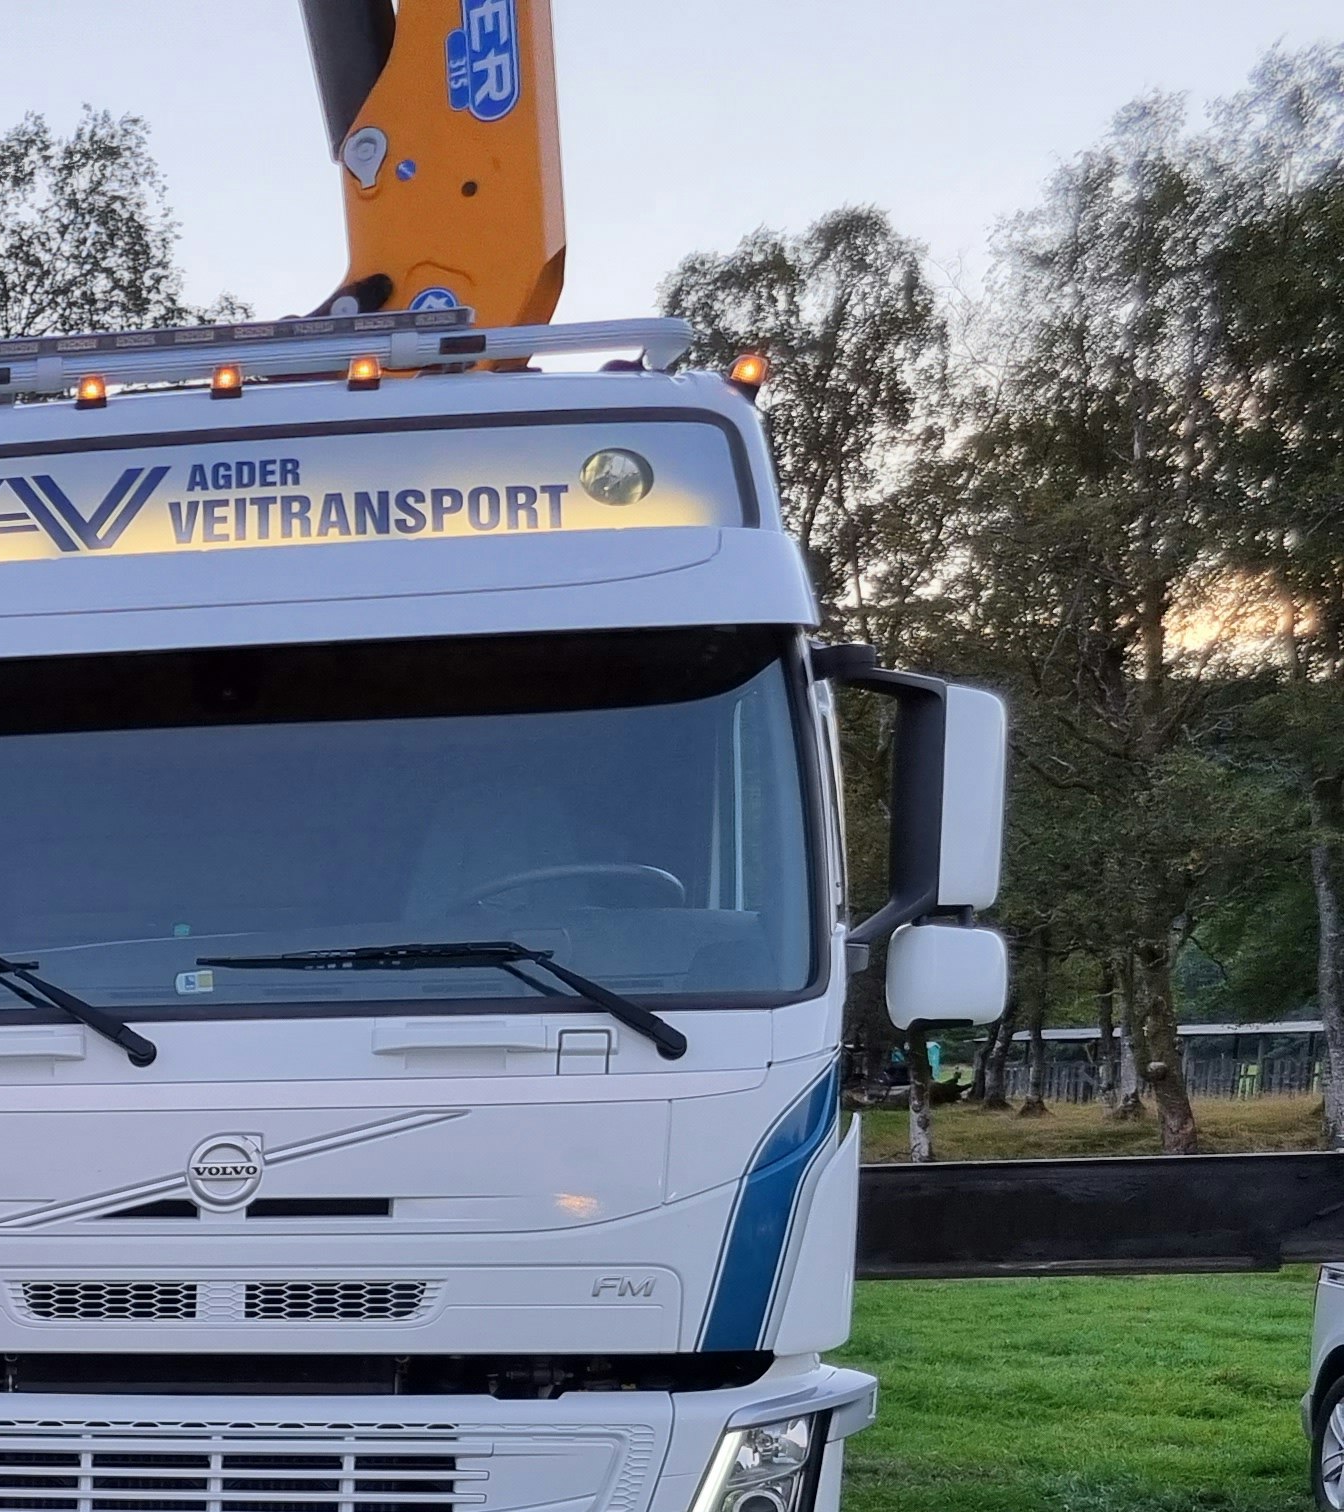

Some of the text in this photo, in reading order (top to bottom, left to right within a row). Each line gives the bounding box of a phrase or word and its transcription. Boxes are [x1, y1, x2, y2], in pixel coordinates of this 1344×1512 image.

[186, 458, 301, 492] AGDER
[168, 484, 569, 544] VEITRANSPORT
[192, 1165, 258, 1176] VOLVO
[591, 1275, 656, 1297] FM
